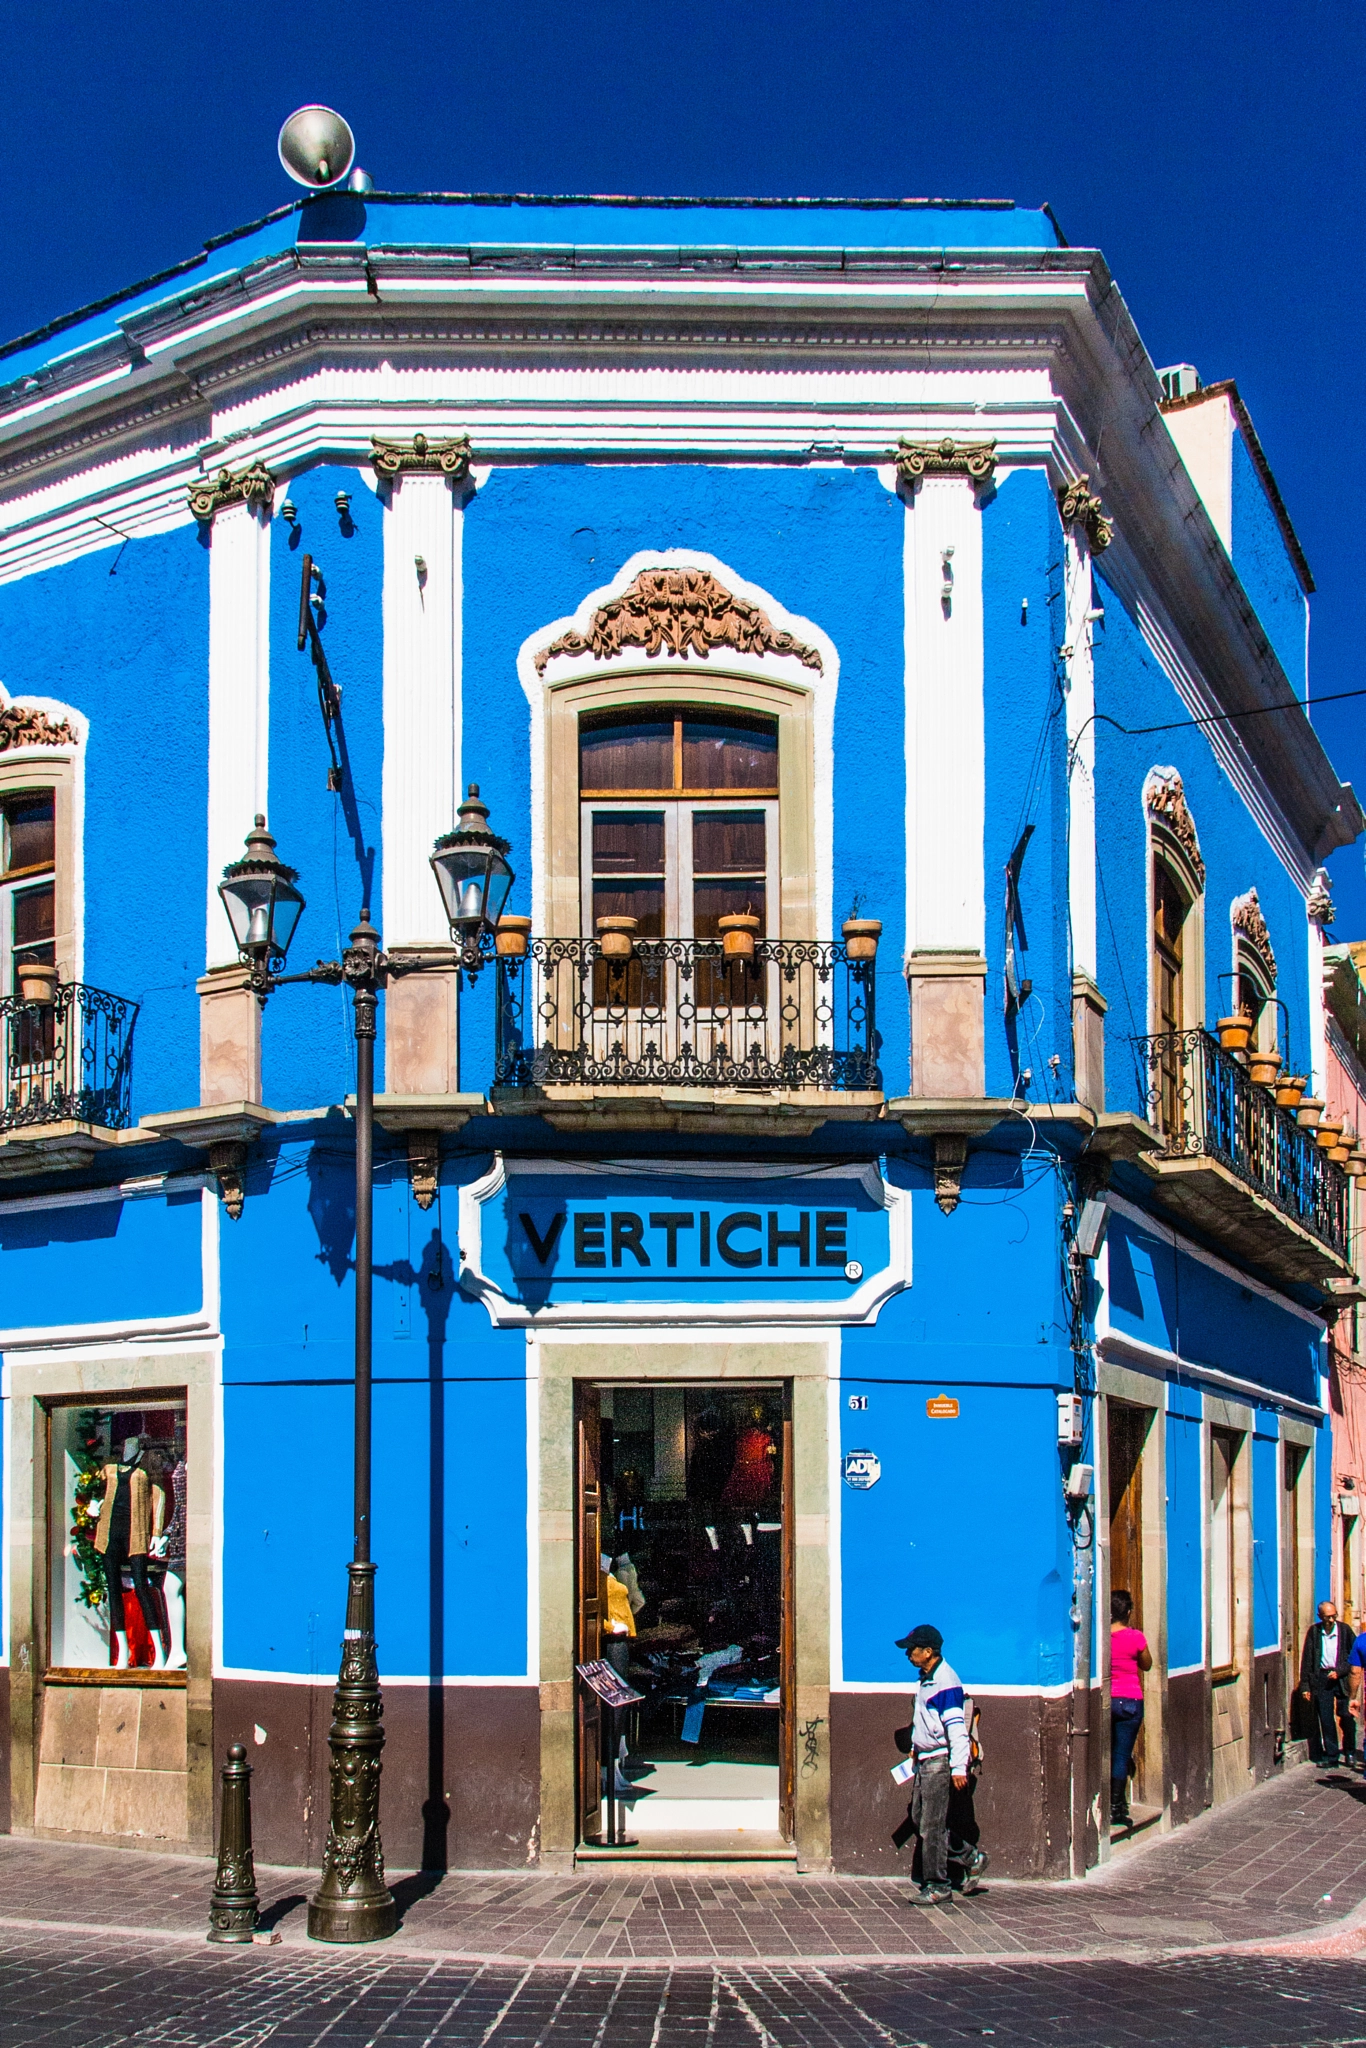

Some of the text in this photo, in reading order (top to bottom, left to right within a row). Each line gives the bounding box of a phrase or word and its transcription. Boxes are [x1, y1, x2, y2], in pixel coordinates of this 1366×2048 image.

[518, 1211, 849, 1269] VERTICHE
[849, 1396, 866, 1410] 51
[846, 1459, 875, 1474] ADT
